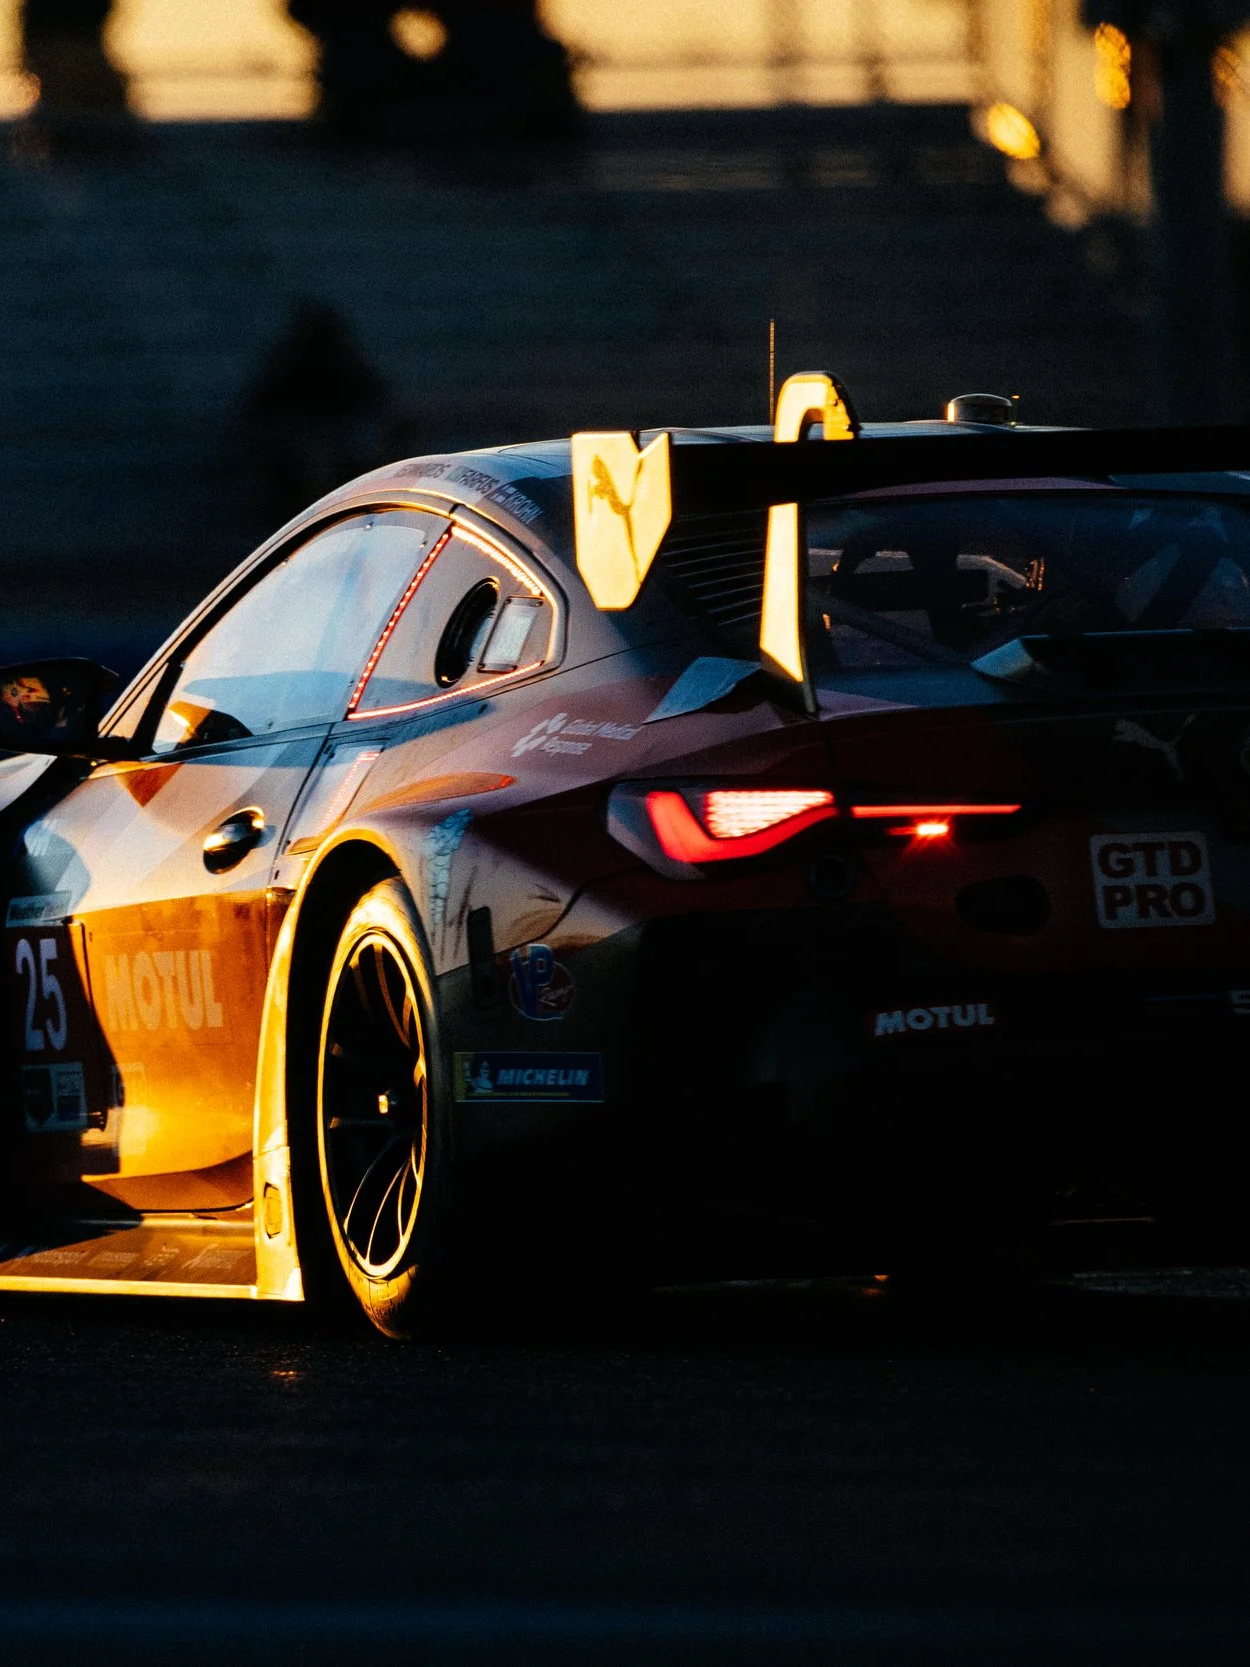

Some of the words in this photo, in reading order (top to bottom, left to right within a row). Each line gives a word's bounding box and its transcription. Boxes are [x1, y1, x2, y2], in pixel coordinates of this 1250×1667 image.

[1100, 841, 1200, 878] GTD
[1103, 882, 1204, 919] PRO
[15, 938, 68, 1052] 25
[105, 949, 224, 1032] MOTUL
[875, 1001, 996, 1037] MOTUL
[496, 1068, 591, 1087] MICHELIN
